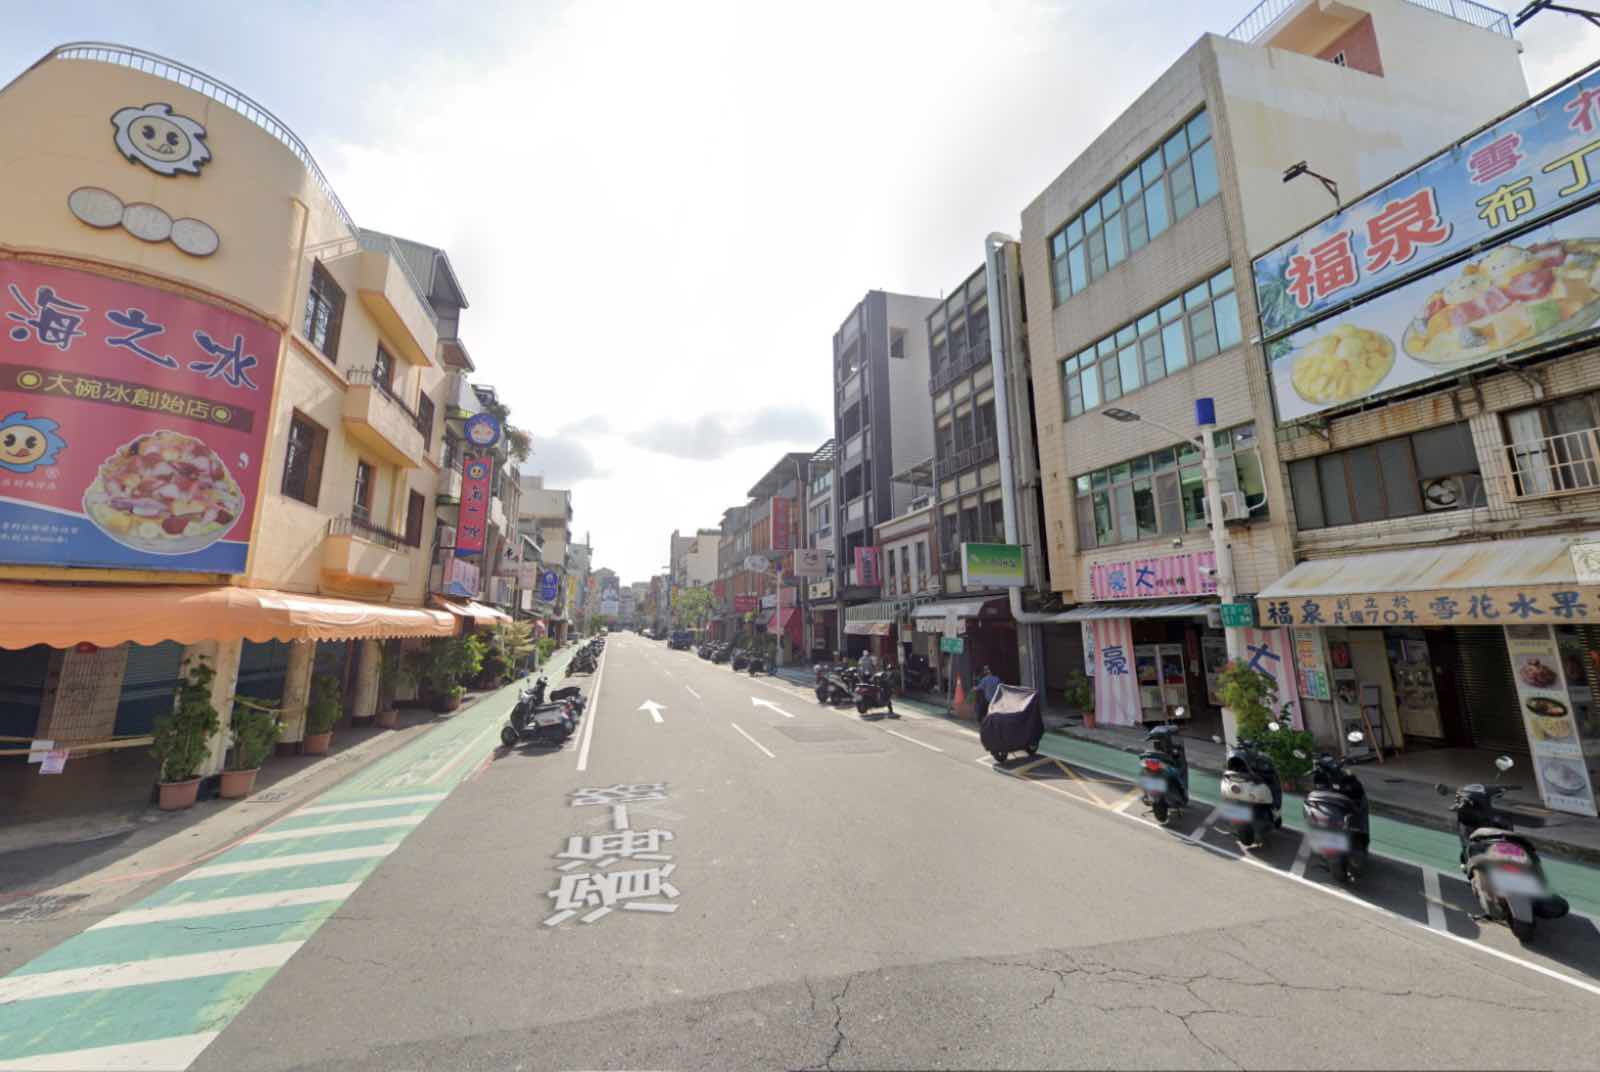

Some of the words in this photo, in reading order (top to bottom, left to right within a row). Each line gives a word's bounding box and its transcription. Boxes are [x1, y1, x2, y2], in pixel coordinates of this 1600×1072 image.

[1286, 186, 1452, 308] 福泉
[7, 284, 258, 391] 海之冰
[43, 373, 209, 421] 大碗冰創始店
[1108, 566, 1156, 592] 豪大
[1267, 601, 1326, 625] 福泉
[1429, 591, 1588, 619] 雪花水果
[1101, 644, 1129, 676] 豪
